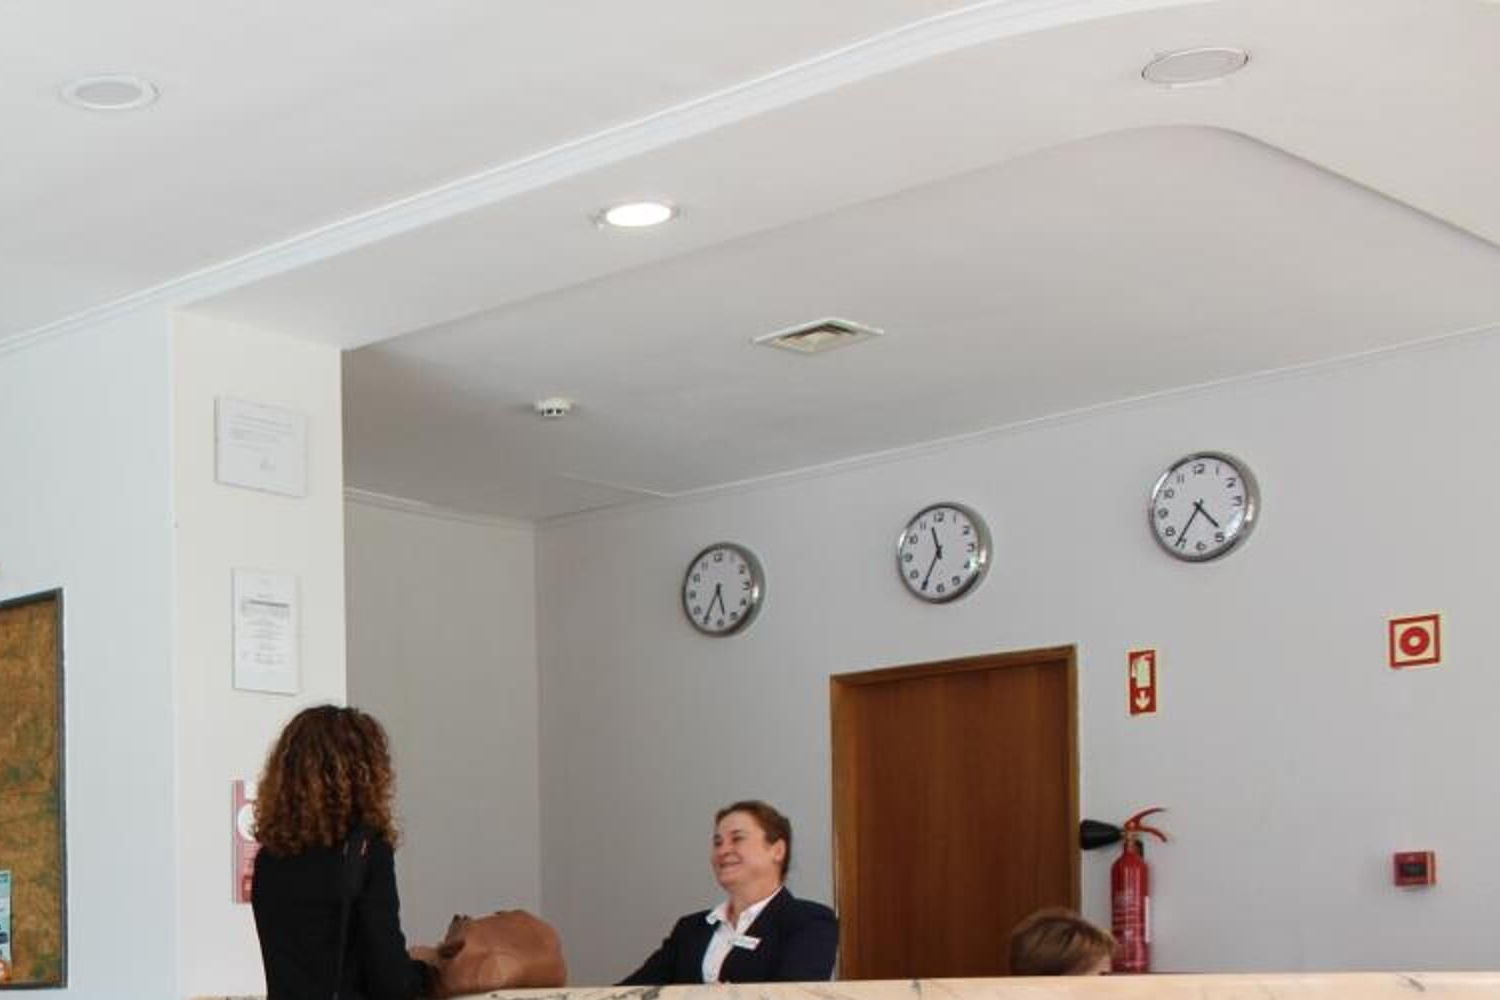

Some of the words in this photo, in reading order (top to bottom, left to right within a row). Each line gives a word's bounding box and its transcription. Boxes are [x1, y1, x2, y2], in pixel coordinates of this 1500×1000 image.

[1193, 463, 1205, 475] 12
[1226, 477, 1236, 489] 2
[1232, 495, 1242, 507] 3
[1165, 526, 1176, 537] 8
[1214, 531, 1225, 543] 5
[1195, 541, 1206, 552] 6
